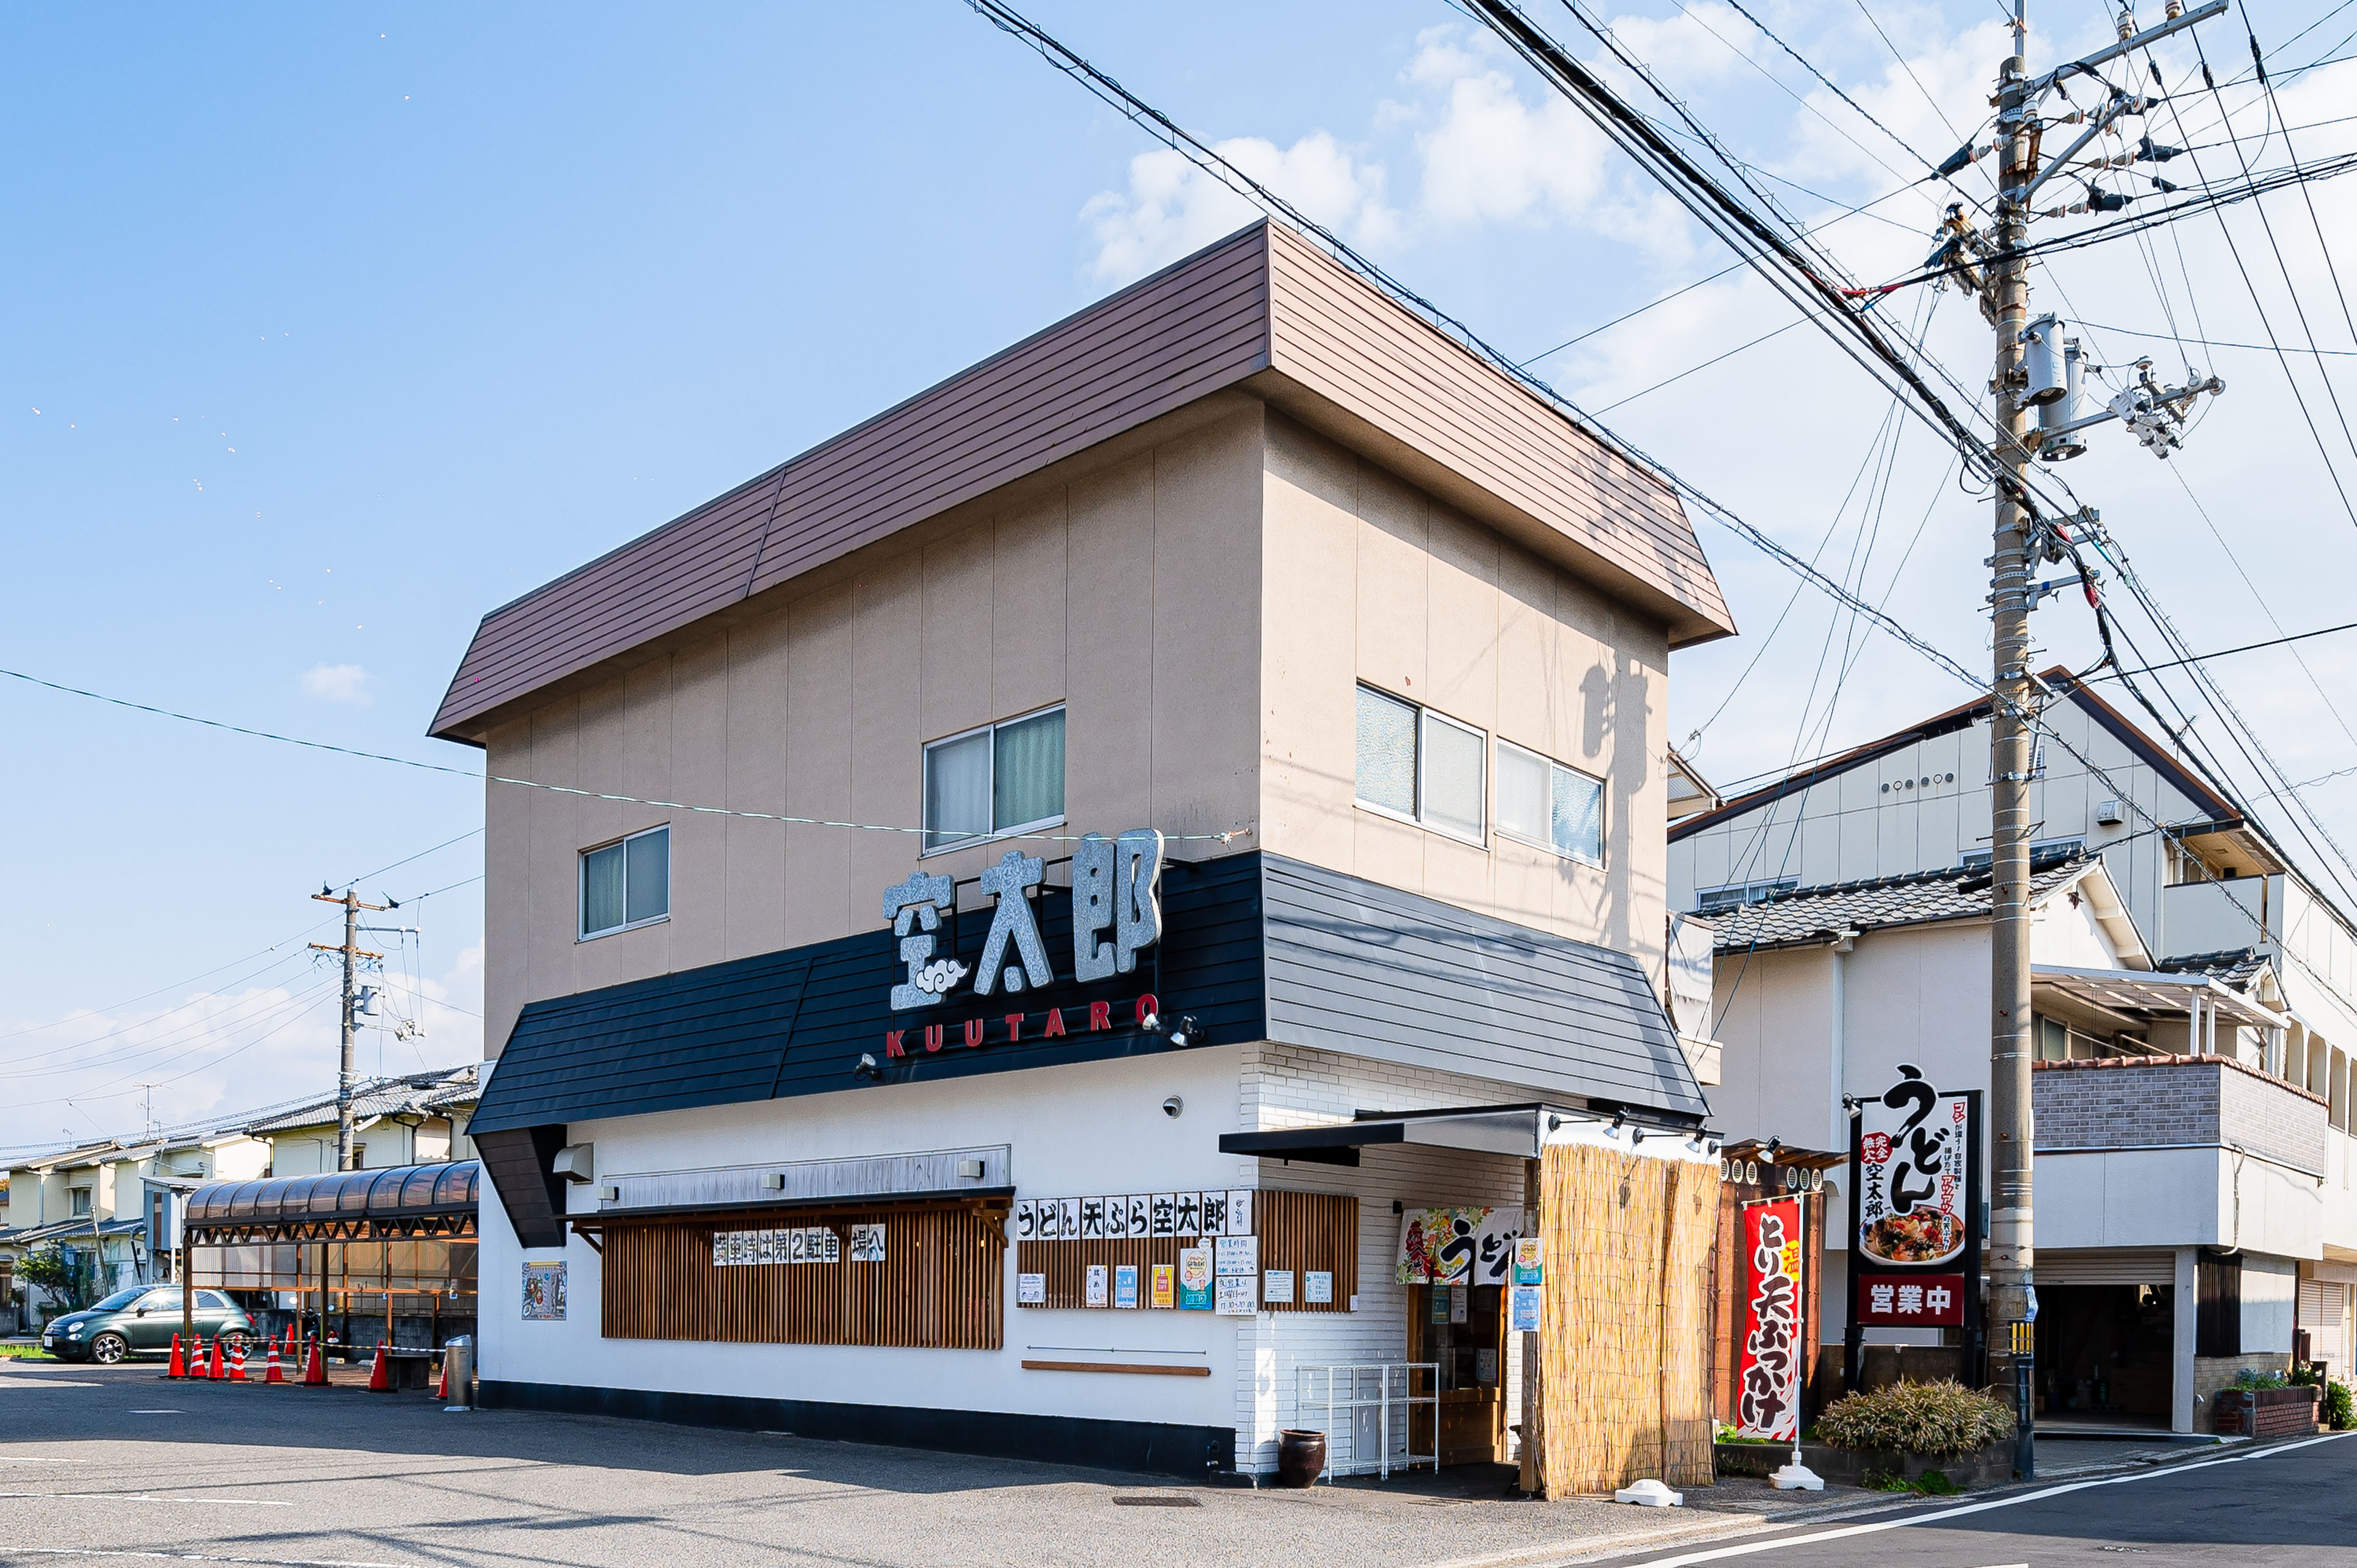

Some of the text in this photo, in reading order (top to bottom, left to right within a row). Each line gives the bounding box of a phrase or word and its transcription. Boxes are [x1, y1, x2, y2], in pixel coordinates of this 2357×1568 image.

[887, 994, 1159, 1057] KUUTARO
[1884, 1064, 1950, 1213] うどん
[1865, 1163, 1885, 1219] 空太郎
[1784, 1246, 1799, 1274] 温
[1742, 1216, 1792, 1429] とり天ぶっかけ
[1871, 1284, 1951, 1315] 営業中
